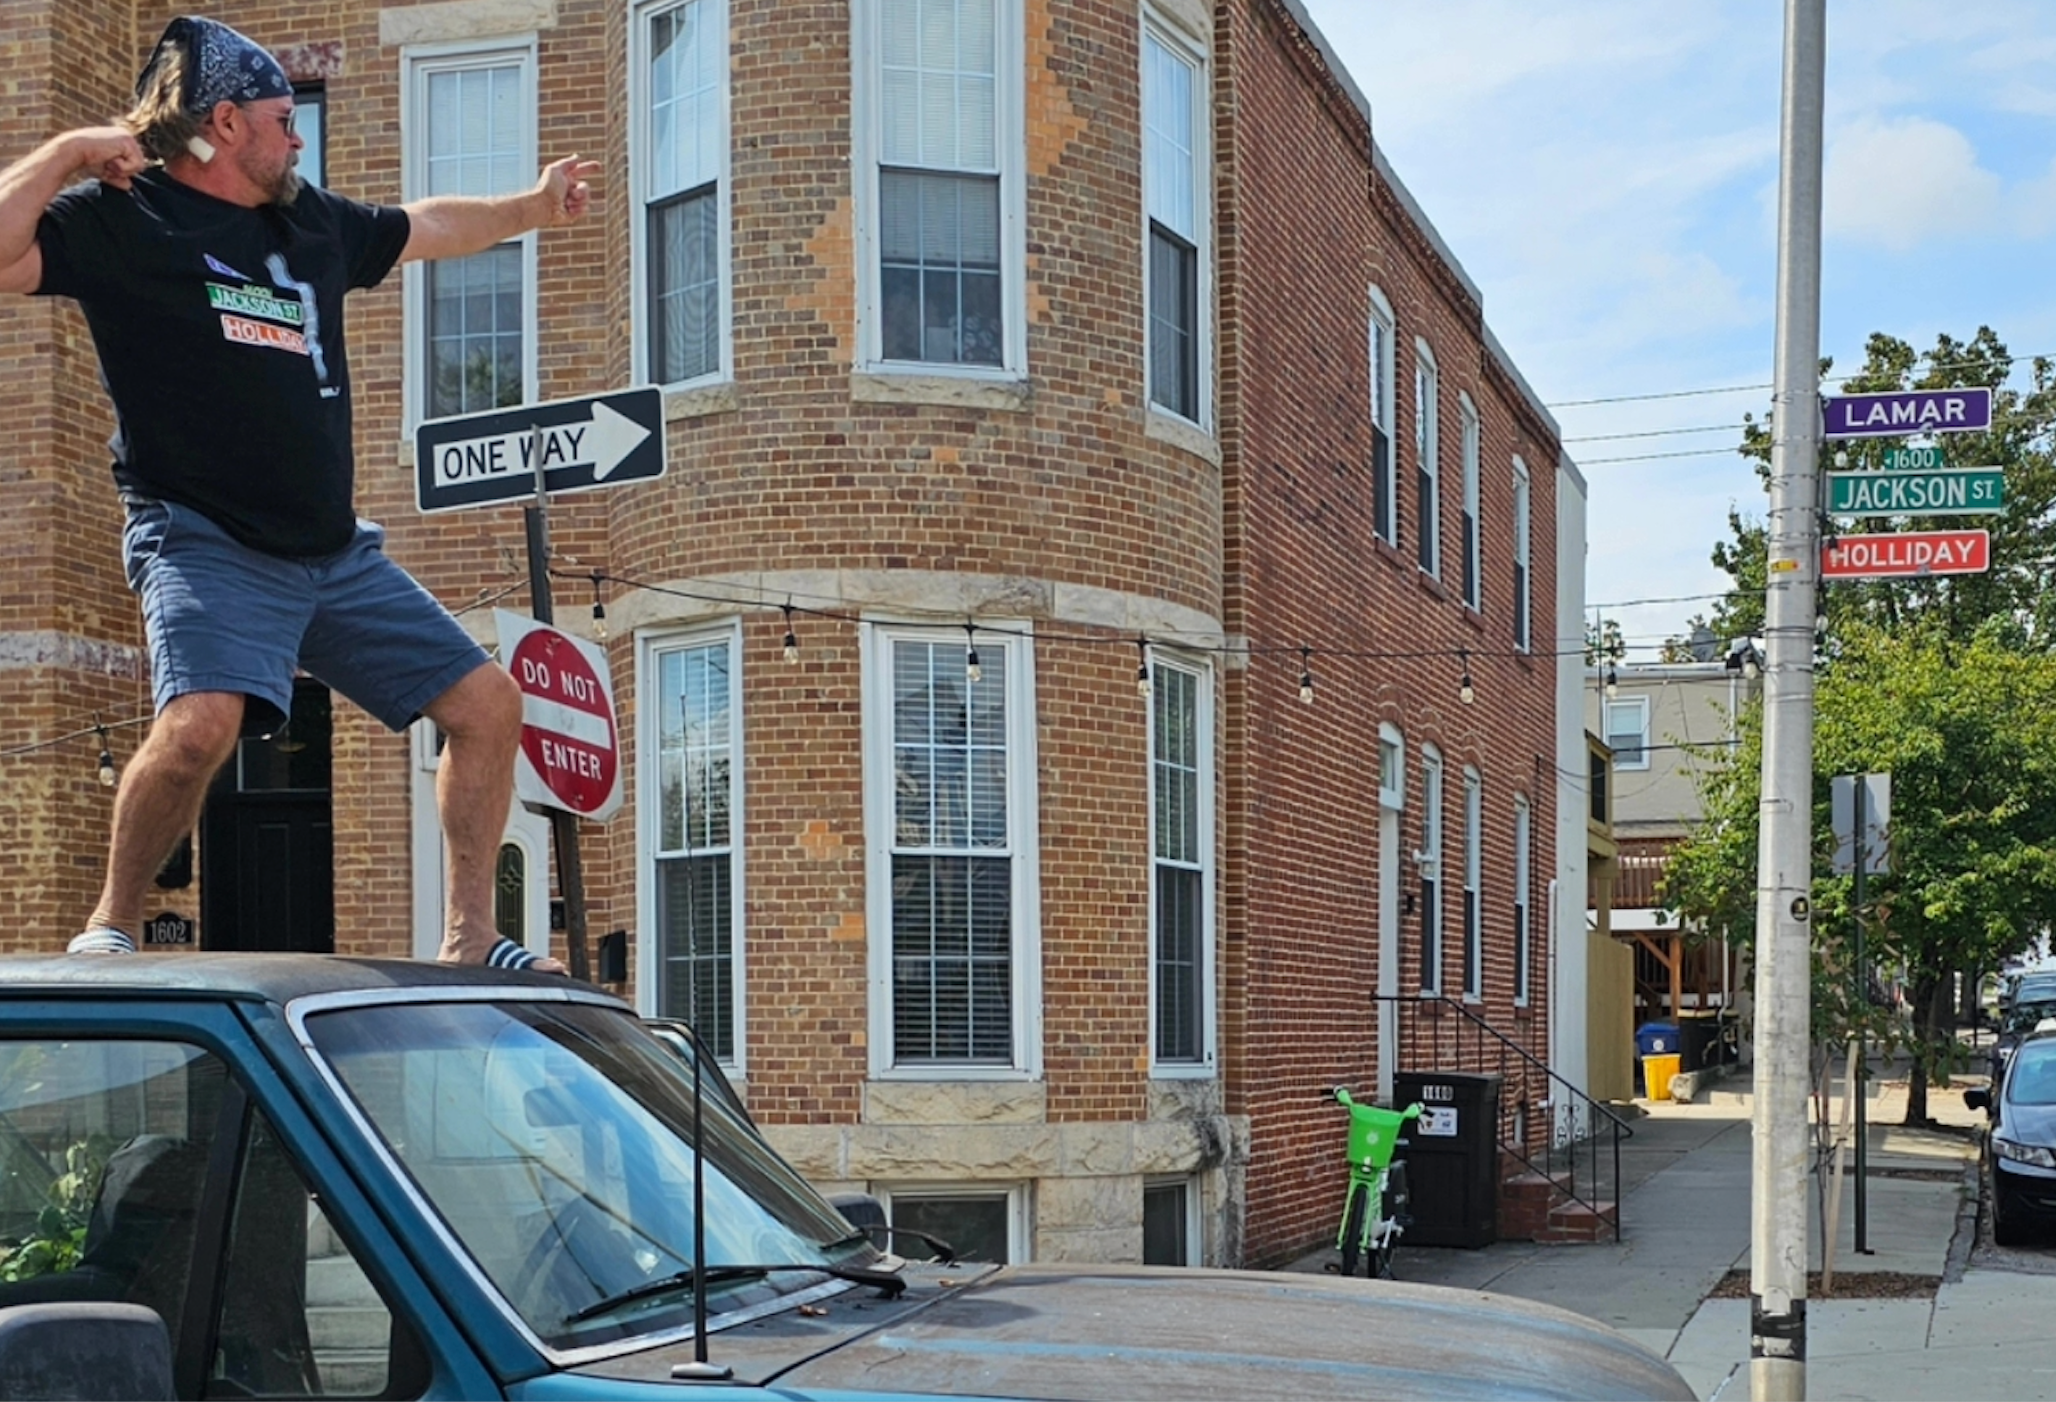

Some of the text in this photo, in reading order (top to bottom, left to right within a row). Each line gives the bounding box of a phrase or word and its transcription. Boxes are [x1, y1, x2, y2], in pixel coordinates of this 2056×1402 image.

[210, 286, 285, 318] JACKSON
[1845, 398, 1966, 427] LAMAR
[444, 427, 585, 479] ONE WAY
[1893, 449, 1936, 469] 1600
[1838, 476, 1967, 510] JACKSON
[1829, 539, 1976, 568] HOLLIDAY
[521, 656, 596, 704] DO NOT
[541, 738, 603, 781] ENTER
[151, 921, 186, 943] 1602
